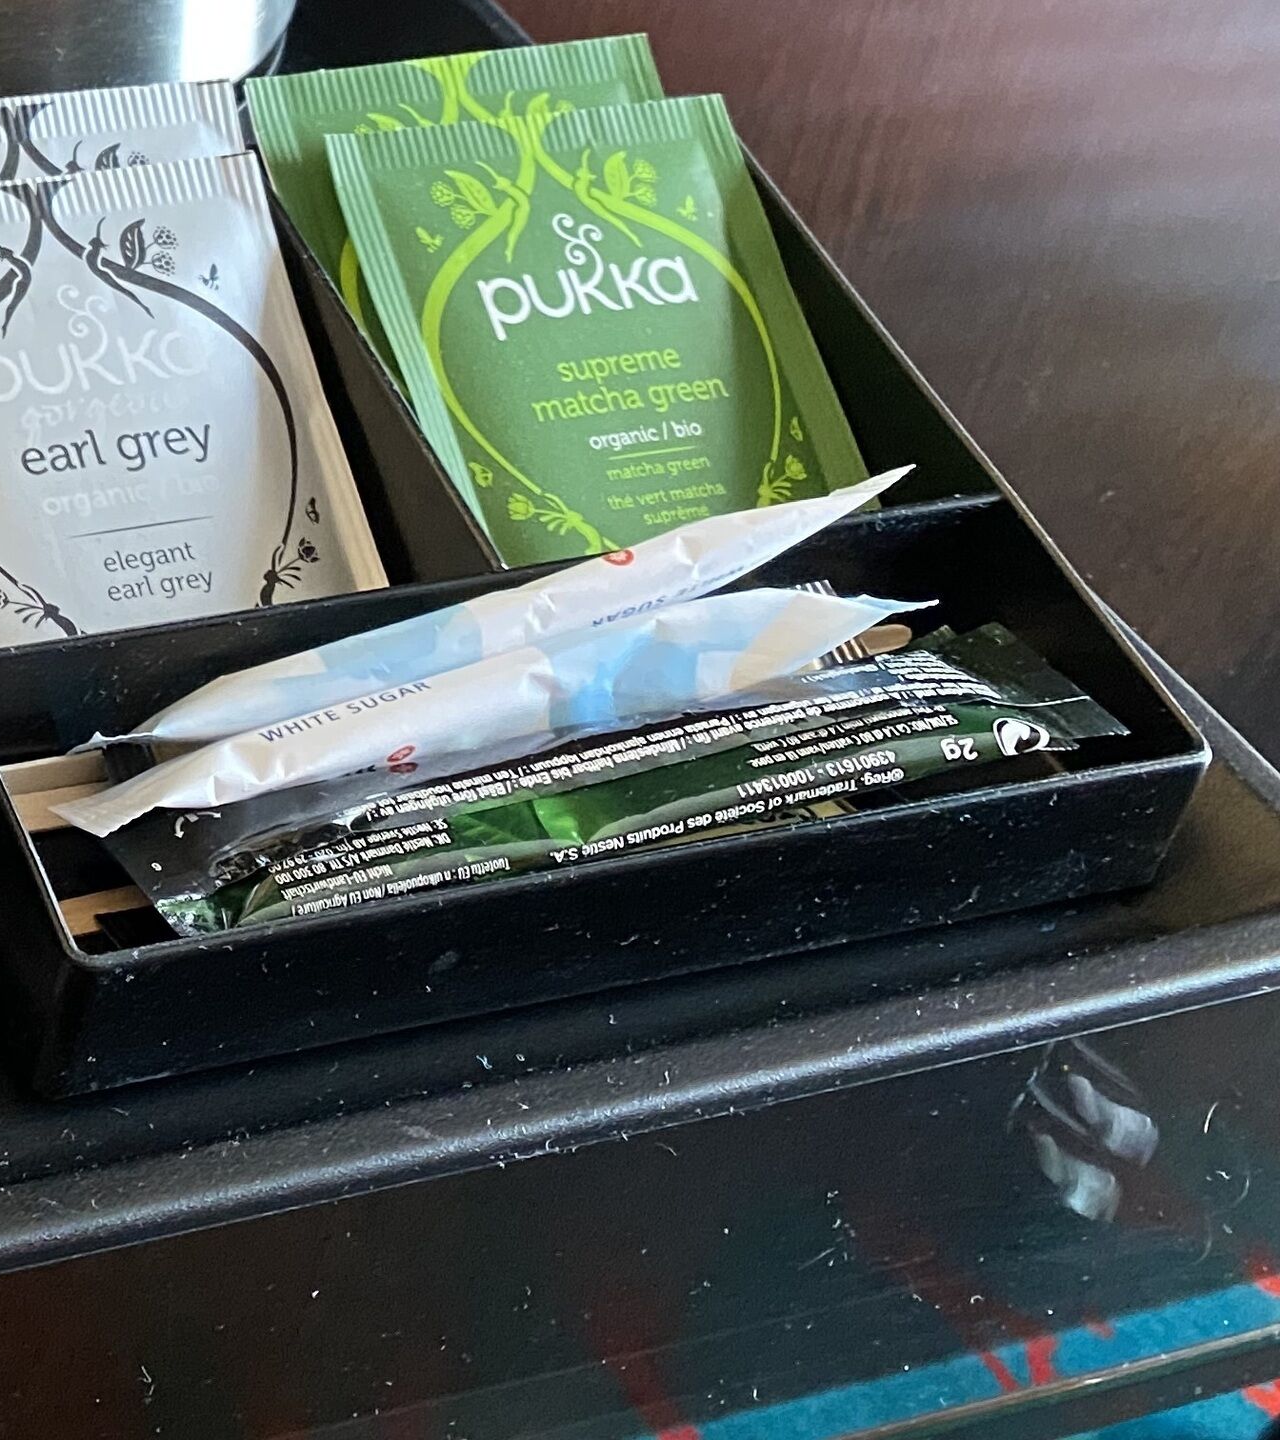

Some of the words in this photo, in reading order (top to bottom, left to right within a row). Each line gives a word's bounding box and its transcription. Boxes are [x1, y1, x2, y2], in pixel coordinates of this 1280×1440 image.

[476, 213, 699, 341] pukka
[557, 348, 681, 383] supreme
[531, 386, 644, 422] matcha
[648, 378, 730, 413] green
[589, 423, 659, 451] organic
[670, 419, 703, 438] bio
[21, 429, 106, 475] earl
[116, 424, 210, 472] grey
[606, 460, 665, 481] matcha
[667, 456, 711, 477] green
[42, 482, 151, 517] organic
[638, 489, 667, 506] vert
[669, 482, 726, 501] matcha
[103, 542, 197, 573] elegant
[107, 575, 154, 601] earl
[160, 571, 213, 599] grey
[258, 709, 341, 742] WHITE
[345, 681, 432, 715] SUGAR
[940, 737, 979, 761] 2g
[551, 766, 573, 781] bis
[825, 749, 897, 777] 43901613
[519, 771, 552, 788] Ende
[767, 797, 782, 810] of
[785, 779, 858, 805] Trademark
[627, 820, 684, 845] Produits
[687, 813, 713, 829] des
[360, 842, 404, 861] Danmark
[549, 847, 579, 863] S.A.
[274, 872, 293, 885] 100
[293, 866, 313, 880] 300
[312, 863, 327, 876] 80
[458, 864, 471, 880] EU
[297, 894, 348, 916] Agriculture
[349, 891, 362, 905] EU
